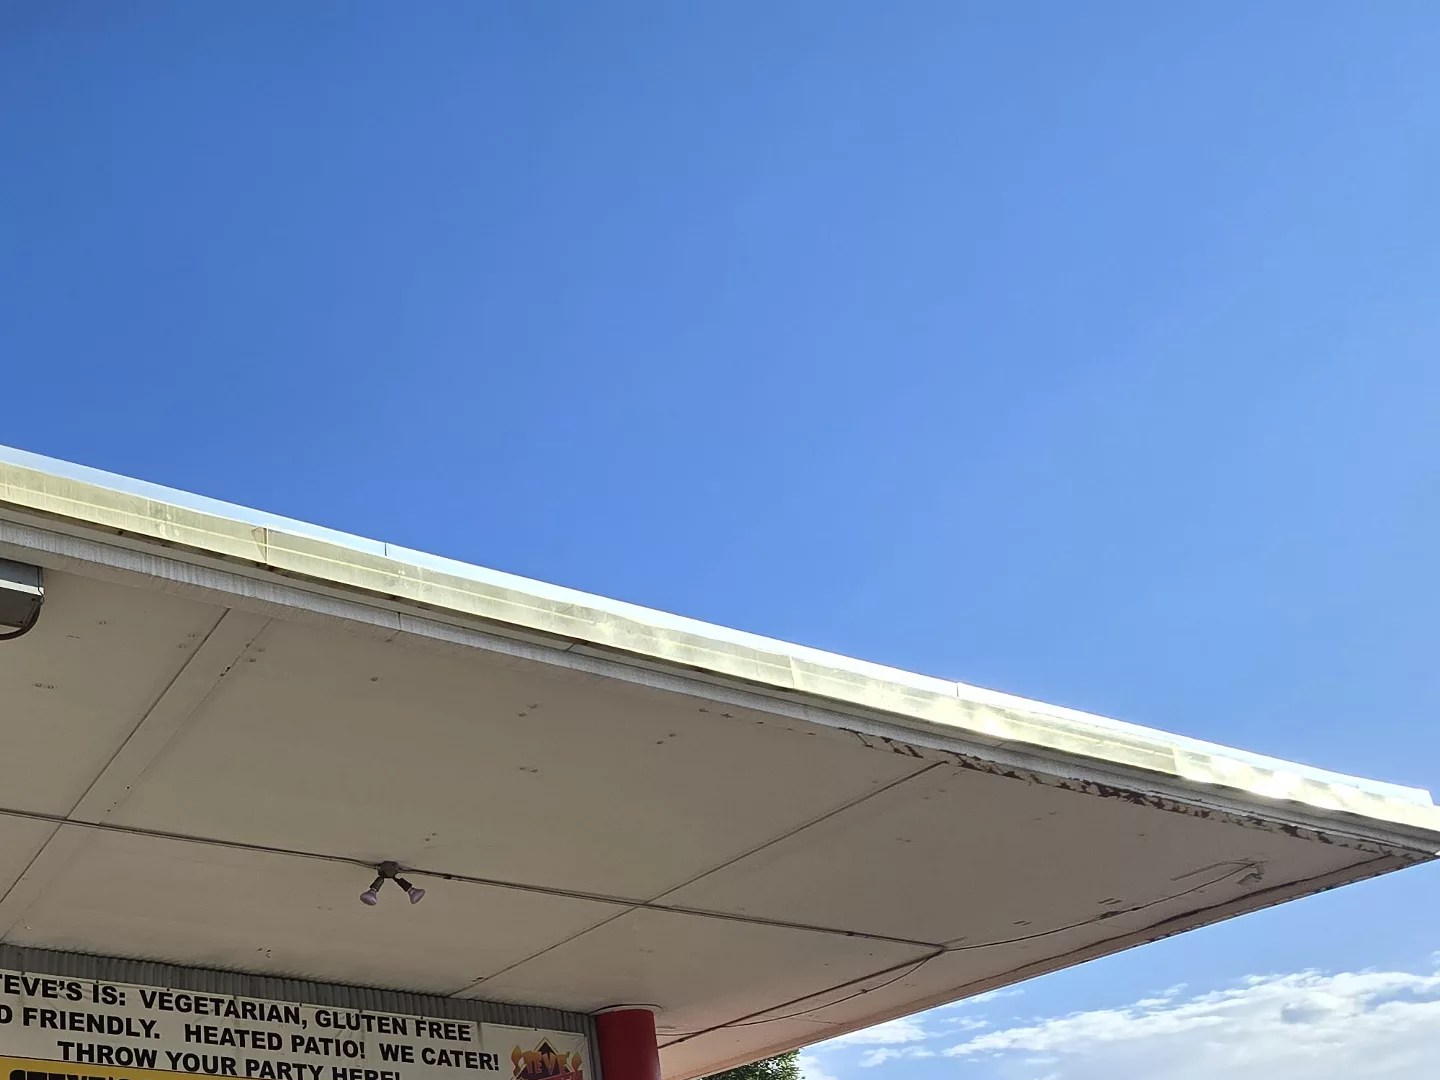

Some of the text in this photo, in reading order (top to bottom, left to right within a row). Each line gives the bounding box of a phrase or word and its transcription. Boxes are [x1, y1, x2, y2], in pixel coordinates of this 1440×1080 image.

[23, 1007, 160, 1039] FRIENDLY.
[185, 1024, 283, 1050] HEATED
[291, 1036, 366, 1059] PATIO!
[379, 1044, 414, 1063] WE
[421, 1047, 499, 1070] CATER!
[92, 984, 126, 1006] IS:
[139, 989, 307, 1029] VEGETARIAN,
[315, 1009, 408, 1035] GLUTEN
[416, 1020, 471, 1041] FREE
[57, 1041, 157, 1068] THROW
[165, 1052, 237, 1076] YOUR
